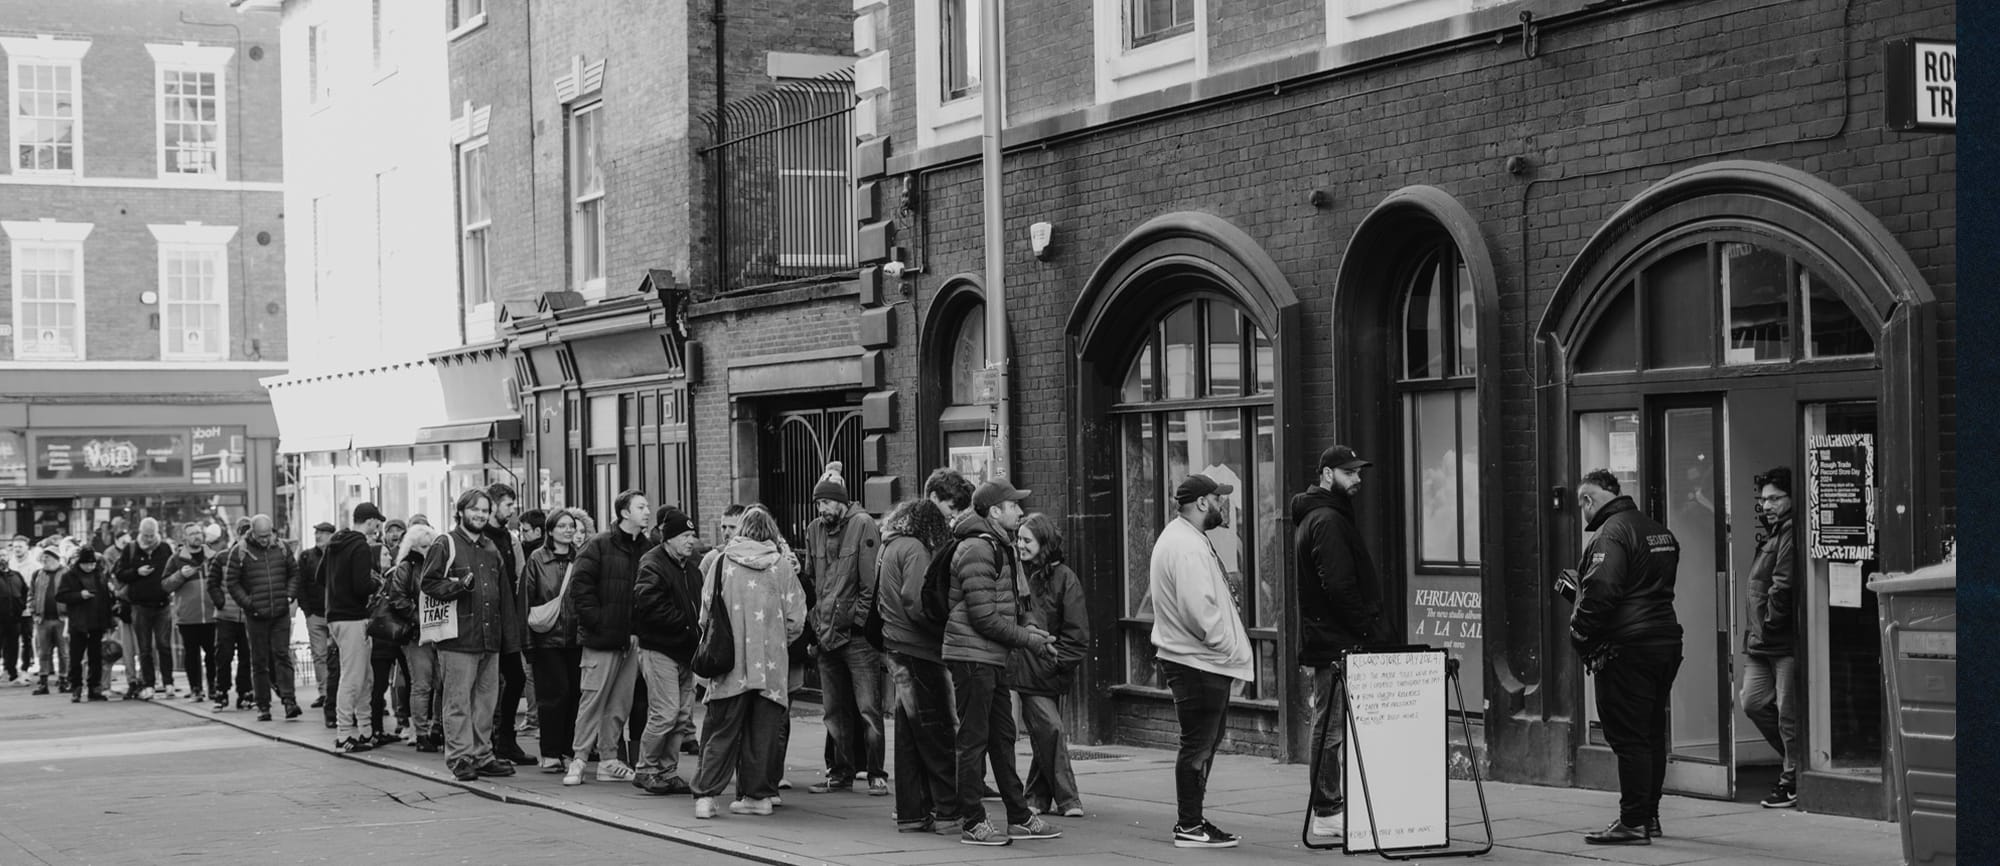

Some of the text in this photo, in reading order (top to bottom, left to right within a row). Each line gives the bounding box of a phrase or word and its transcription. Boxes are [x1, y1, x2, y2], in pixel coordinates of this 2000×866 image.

[1926, 86, 1956, 118] TR
[1820, 461, 1837, 469] Rough
[1851, 468, 1861, 477] Day
[1646, 534, 1673, 546] SECURITY
[1416, 619, 1425, 635] A
[1434, 620, 1450, 637] LA
